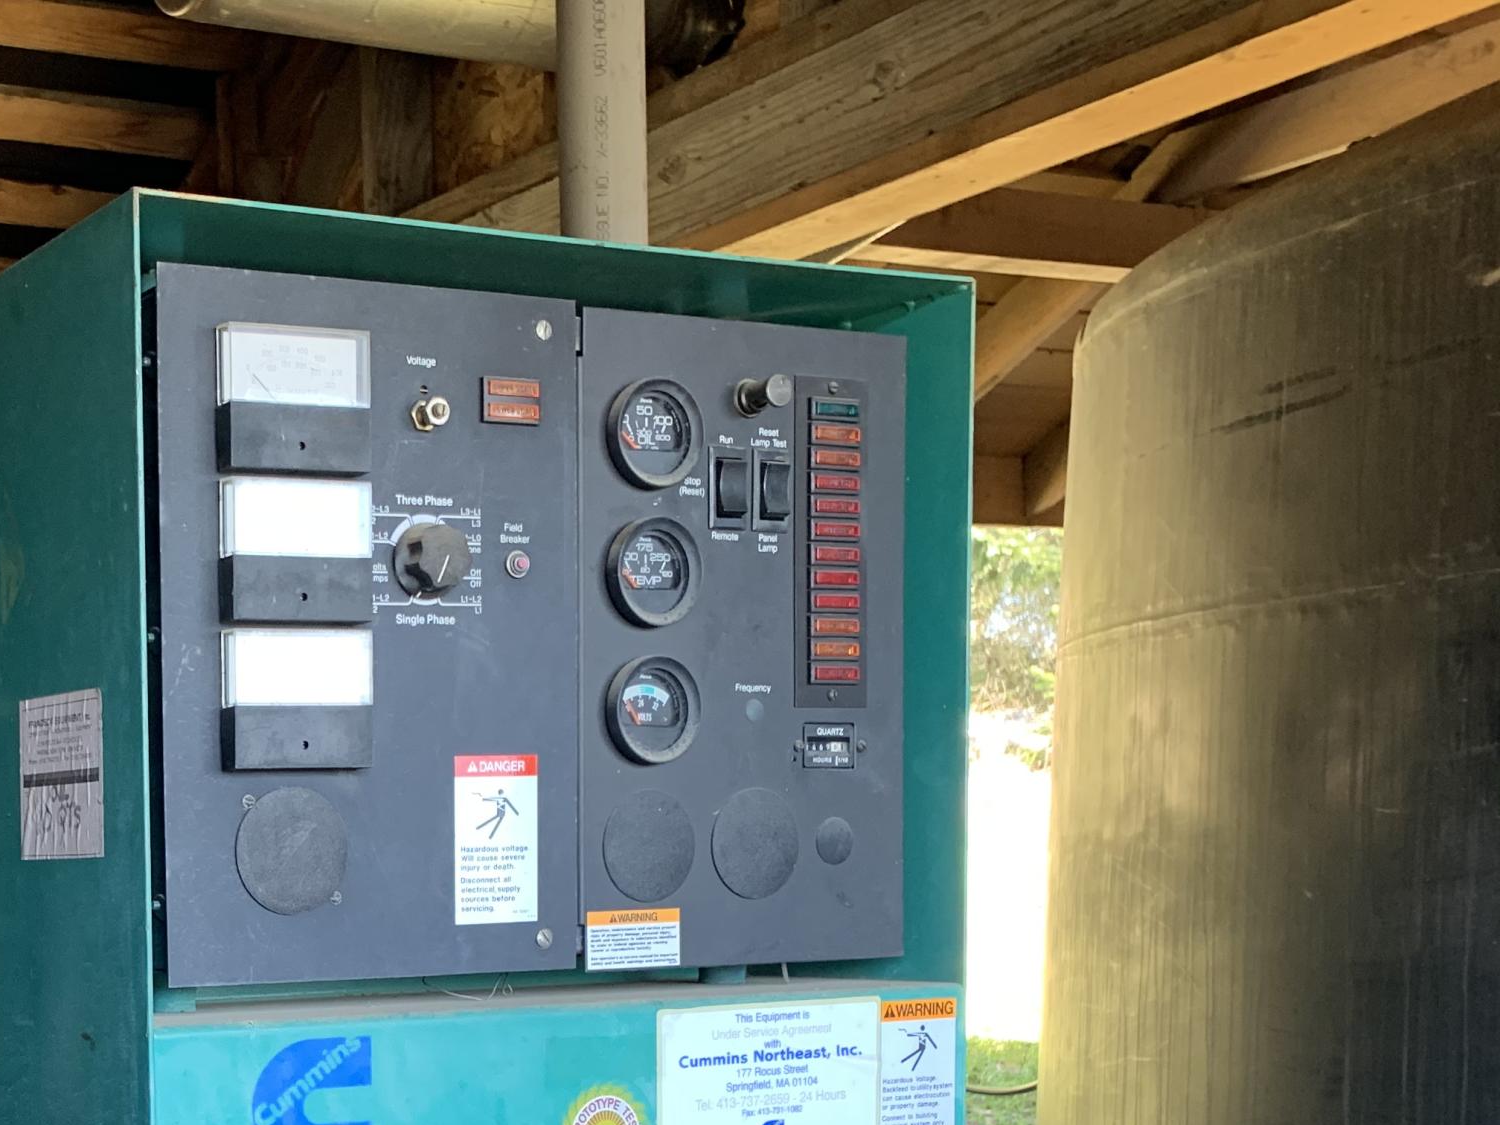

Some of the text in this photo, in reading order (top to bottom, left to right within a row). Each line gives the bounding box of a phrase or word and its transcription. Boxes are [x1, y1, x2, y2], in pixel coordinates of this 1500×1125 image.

[406, 355, 436, 368] Voltage
[636, 405, 653, 415] 50
[653, 416, 673, 426] 100
[759, 427, 779, 437] Reset
[719, 435, 734, 444] Run
[750, 438, 787, 448] Lamp Test
[684, 477, 702, 487] Stop
[679, 486, 705, 498] (Reset)
[395, 494, 454, 507] Three Phase
[372, 505, 390, 513] 2-L3
[471, 520, 481, 528] L3
[504, 523, 523, 533] Field
[500, 534, 530, 544] Breaker
[711, 531, 739, 541] Remote
[758, 533, 778, 543] Panel
[758, 544, 778, 554] Lamp
[649, 552, 671, 562] 250
[372, 562, 387, 570] olts
[372, 575, 388, 583] mps
[372, 594, 390, 602] 1-L2
[395, 613, 456, 626] Single Phase
[734, 683, 772, 694] Frequency
[816, 727, 844, 736] QUARTZ
[479, 760, 525, 773] DANGER
[617, 911, 658, 923] WARNING
[895, 1001, 954, 1017] WARNING
[735, 1010, 810, 1024] This Equipment is
[711, 1023, 832, 1041] Under Service Agreement
[763, 1039, 781, 1049] with
[678, 1044, 863, 1069] Cummins Northeast, Inc.
[737, 1064, 809, 1078] 177 Rocus Street
[776, 1078, 790, 1088] MA
[791, 1076, 818, 1087] 01104
[815, 1089, 847, 1101] Hours
